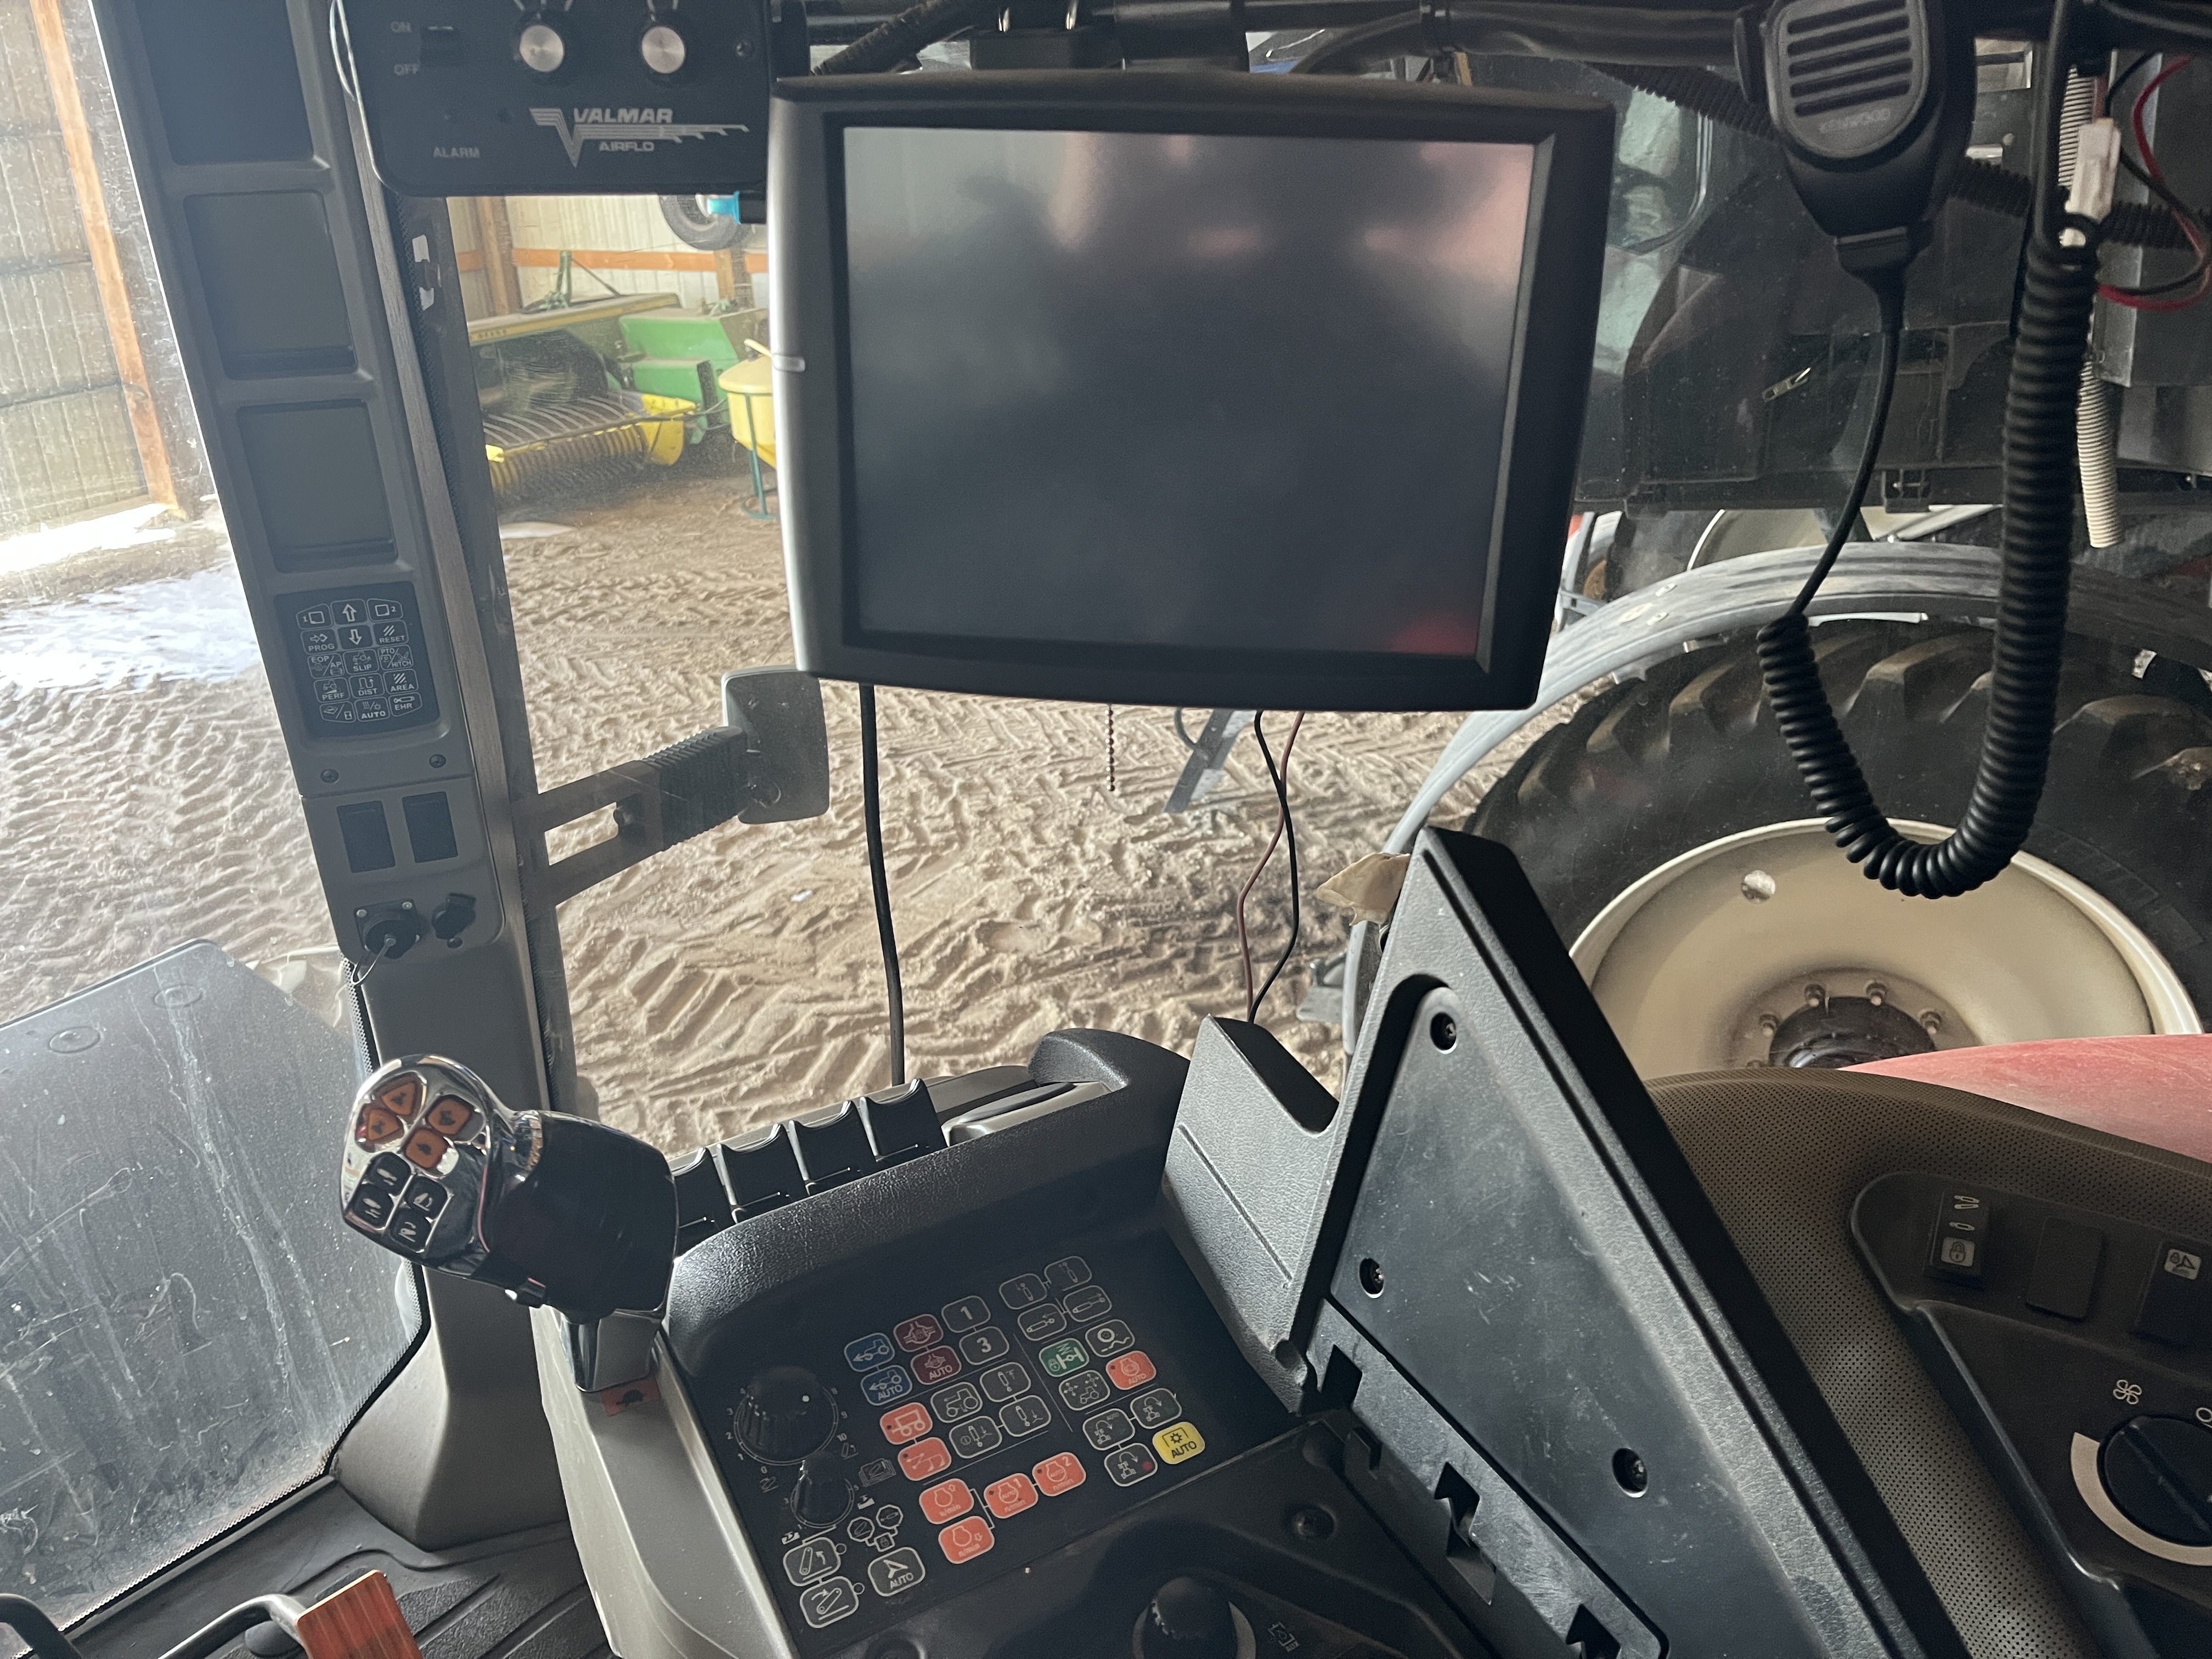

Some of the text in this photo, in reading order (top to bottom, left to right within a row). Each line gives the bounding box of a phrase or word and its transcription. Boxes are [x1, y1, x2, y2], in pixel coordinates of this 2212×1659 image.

[394, 63, 421, 76] OFF
[574, 108, 674, 123] VALMAR
[599, 141, 655, 151] AIRFLO
[433, 146, 481, 159] ALARM
[302, 614, 308, 623] 1
[379, 635, 405, 644] RESET
[308, 643, 335, 652] PROG
[311, 655, 329, 663] EOP
[353, 664, 372, 672] SLIP
[358, 687, 378, 696] DIST
[390, 684, 415, 692] AREA
[322, 692, 346, 701] PERF
[394, 703, 413, 711] EHR
[361, 710, 386, 719] AUTO
[960, 1306, 973, 1321] 1
[977, 1336, 992, 1353] 3
[929, 1364, 953, 1381] AUTO
[1128, 1373, 1147, 1385] AUTO
[878, 1384, 903, 1401] AUTO
[726, 1407, 733, 1415] 3
[840, 1410, 848, 1419] 9
[725, 1431, 733, 1440] 2
[837, 1432, 848, 1442] 10
[1171, 1441, 1198, 1459] AUTO
[1062, 1456, 1073, 1467] 2
[1014, 1478, 1022, 1488] 1
[889, 1572, 914, 1590] AUTO
